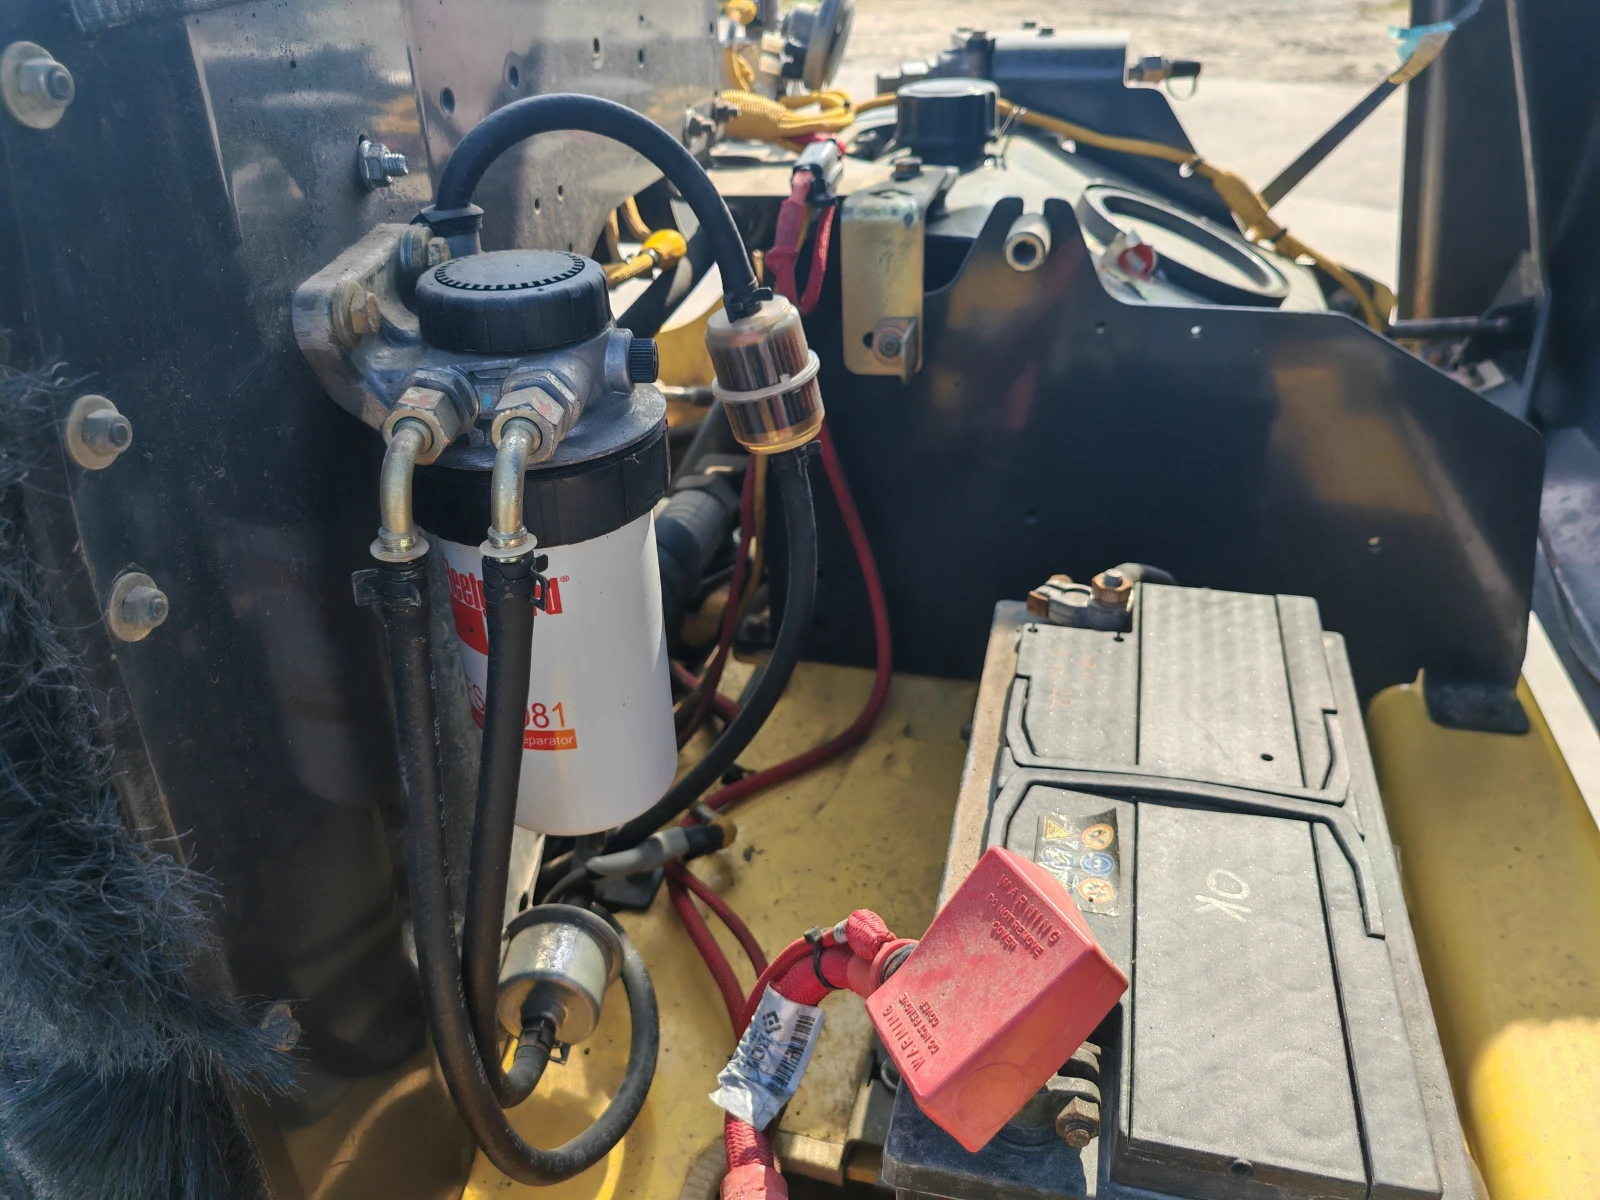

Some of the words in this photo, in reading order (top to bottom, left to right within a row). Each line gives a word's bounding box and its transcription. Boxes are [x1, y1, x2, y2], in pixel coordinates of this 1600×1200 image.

[523, 735, 574, 748] eparator
[985, 892, 999, 907] DO
[997, 904, 1016, 923] NOT
[1011, 920, 1045, 956] REMOVE
[1000, 873, 1062, 944] WARNING
[1195, 868, 1252, 923] OK
[992, 920, 1019, 951] COVER
[882, 1005, 925, 1072] WARNING
